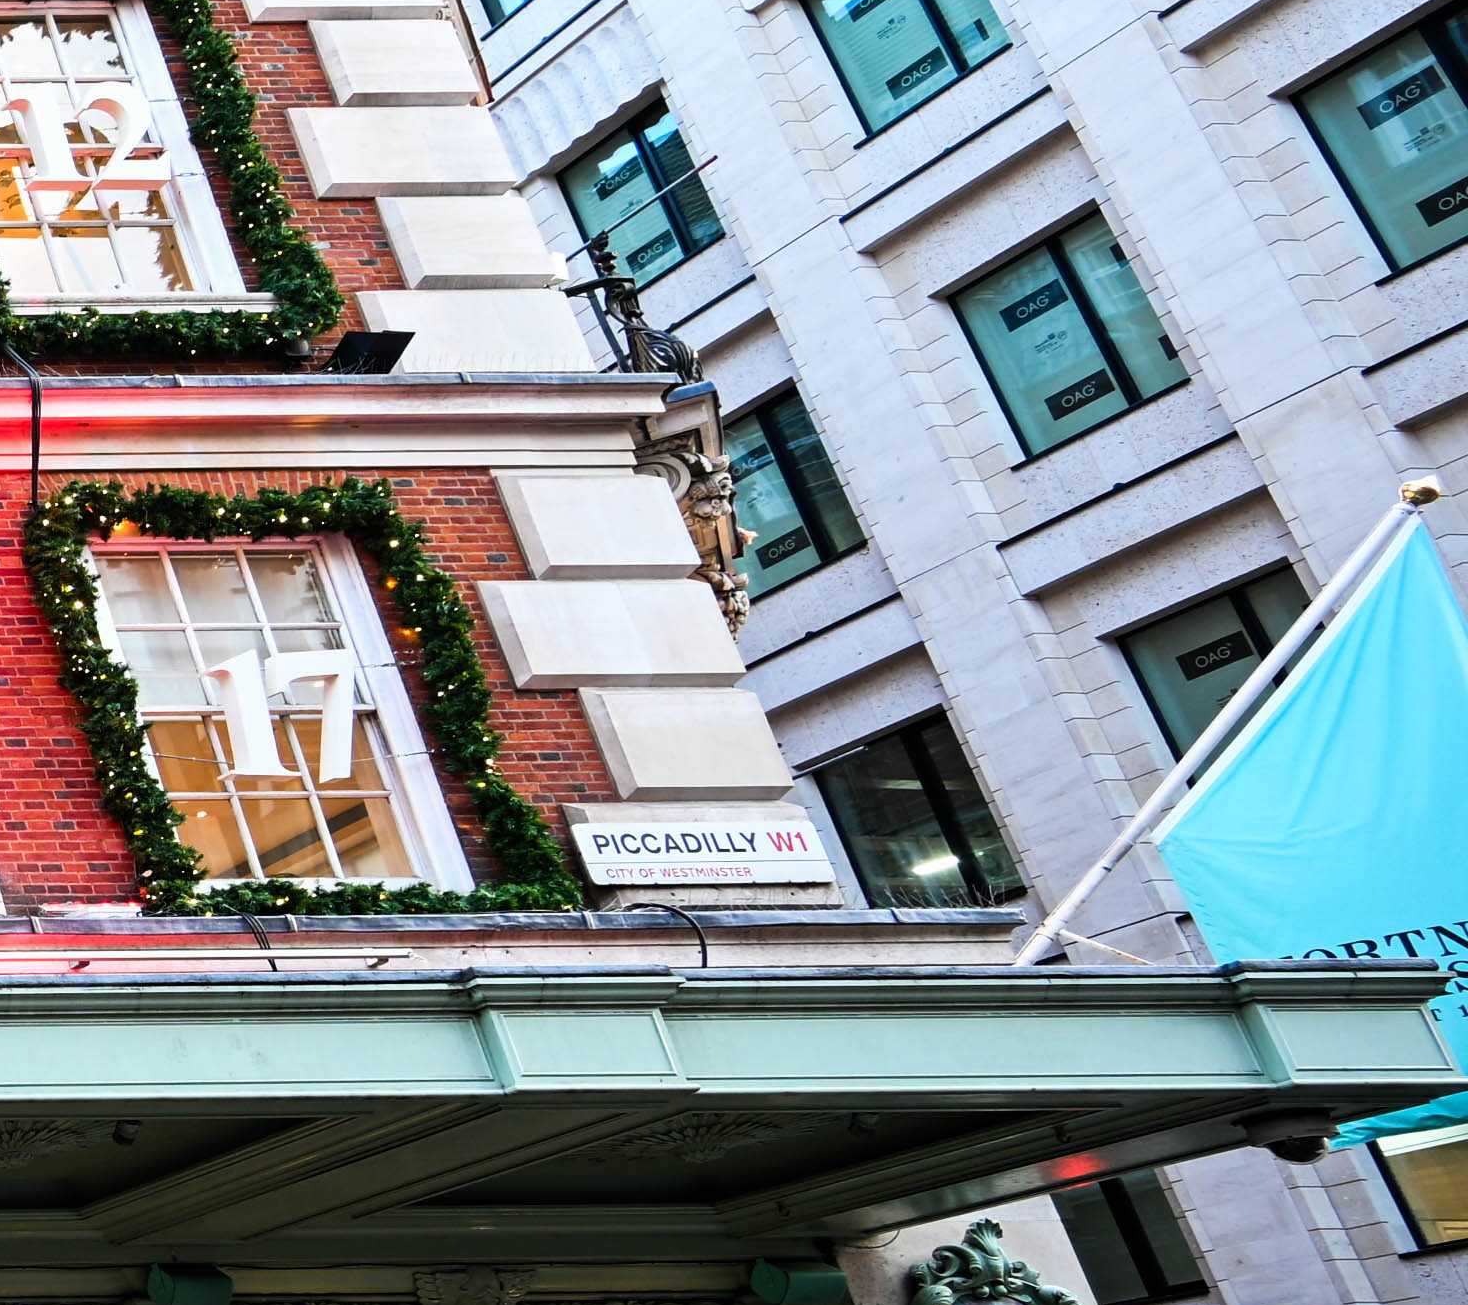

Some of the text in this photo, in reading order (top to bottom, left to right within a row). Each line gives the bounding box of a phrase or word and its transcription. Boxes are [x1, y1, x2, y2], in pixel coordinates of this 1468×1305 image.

[3, 81, 169, 193] 12
[1438, 186, 1468, 211] OA
[204, 648, 354, 783] 17
[592, 831, 808, 854] PICCADILLY W1
[606, 867, 753, 879] CITY OF WESTMINSTER
